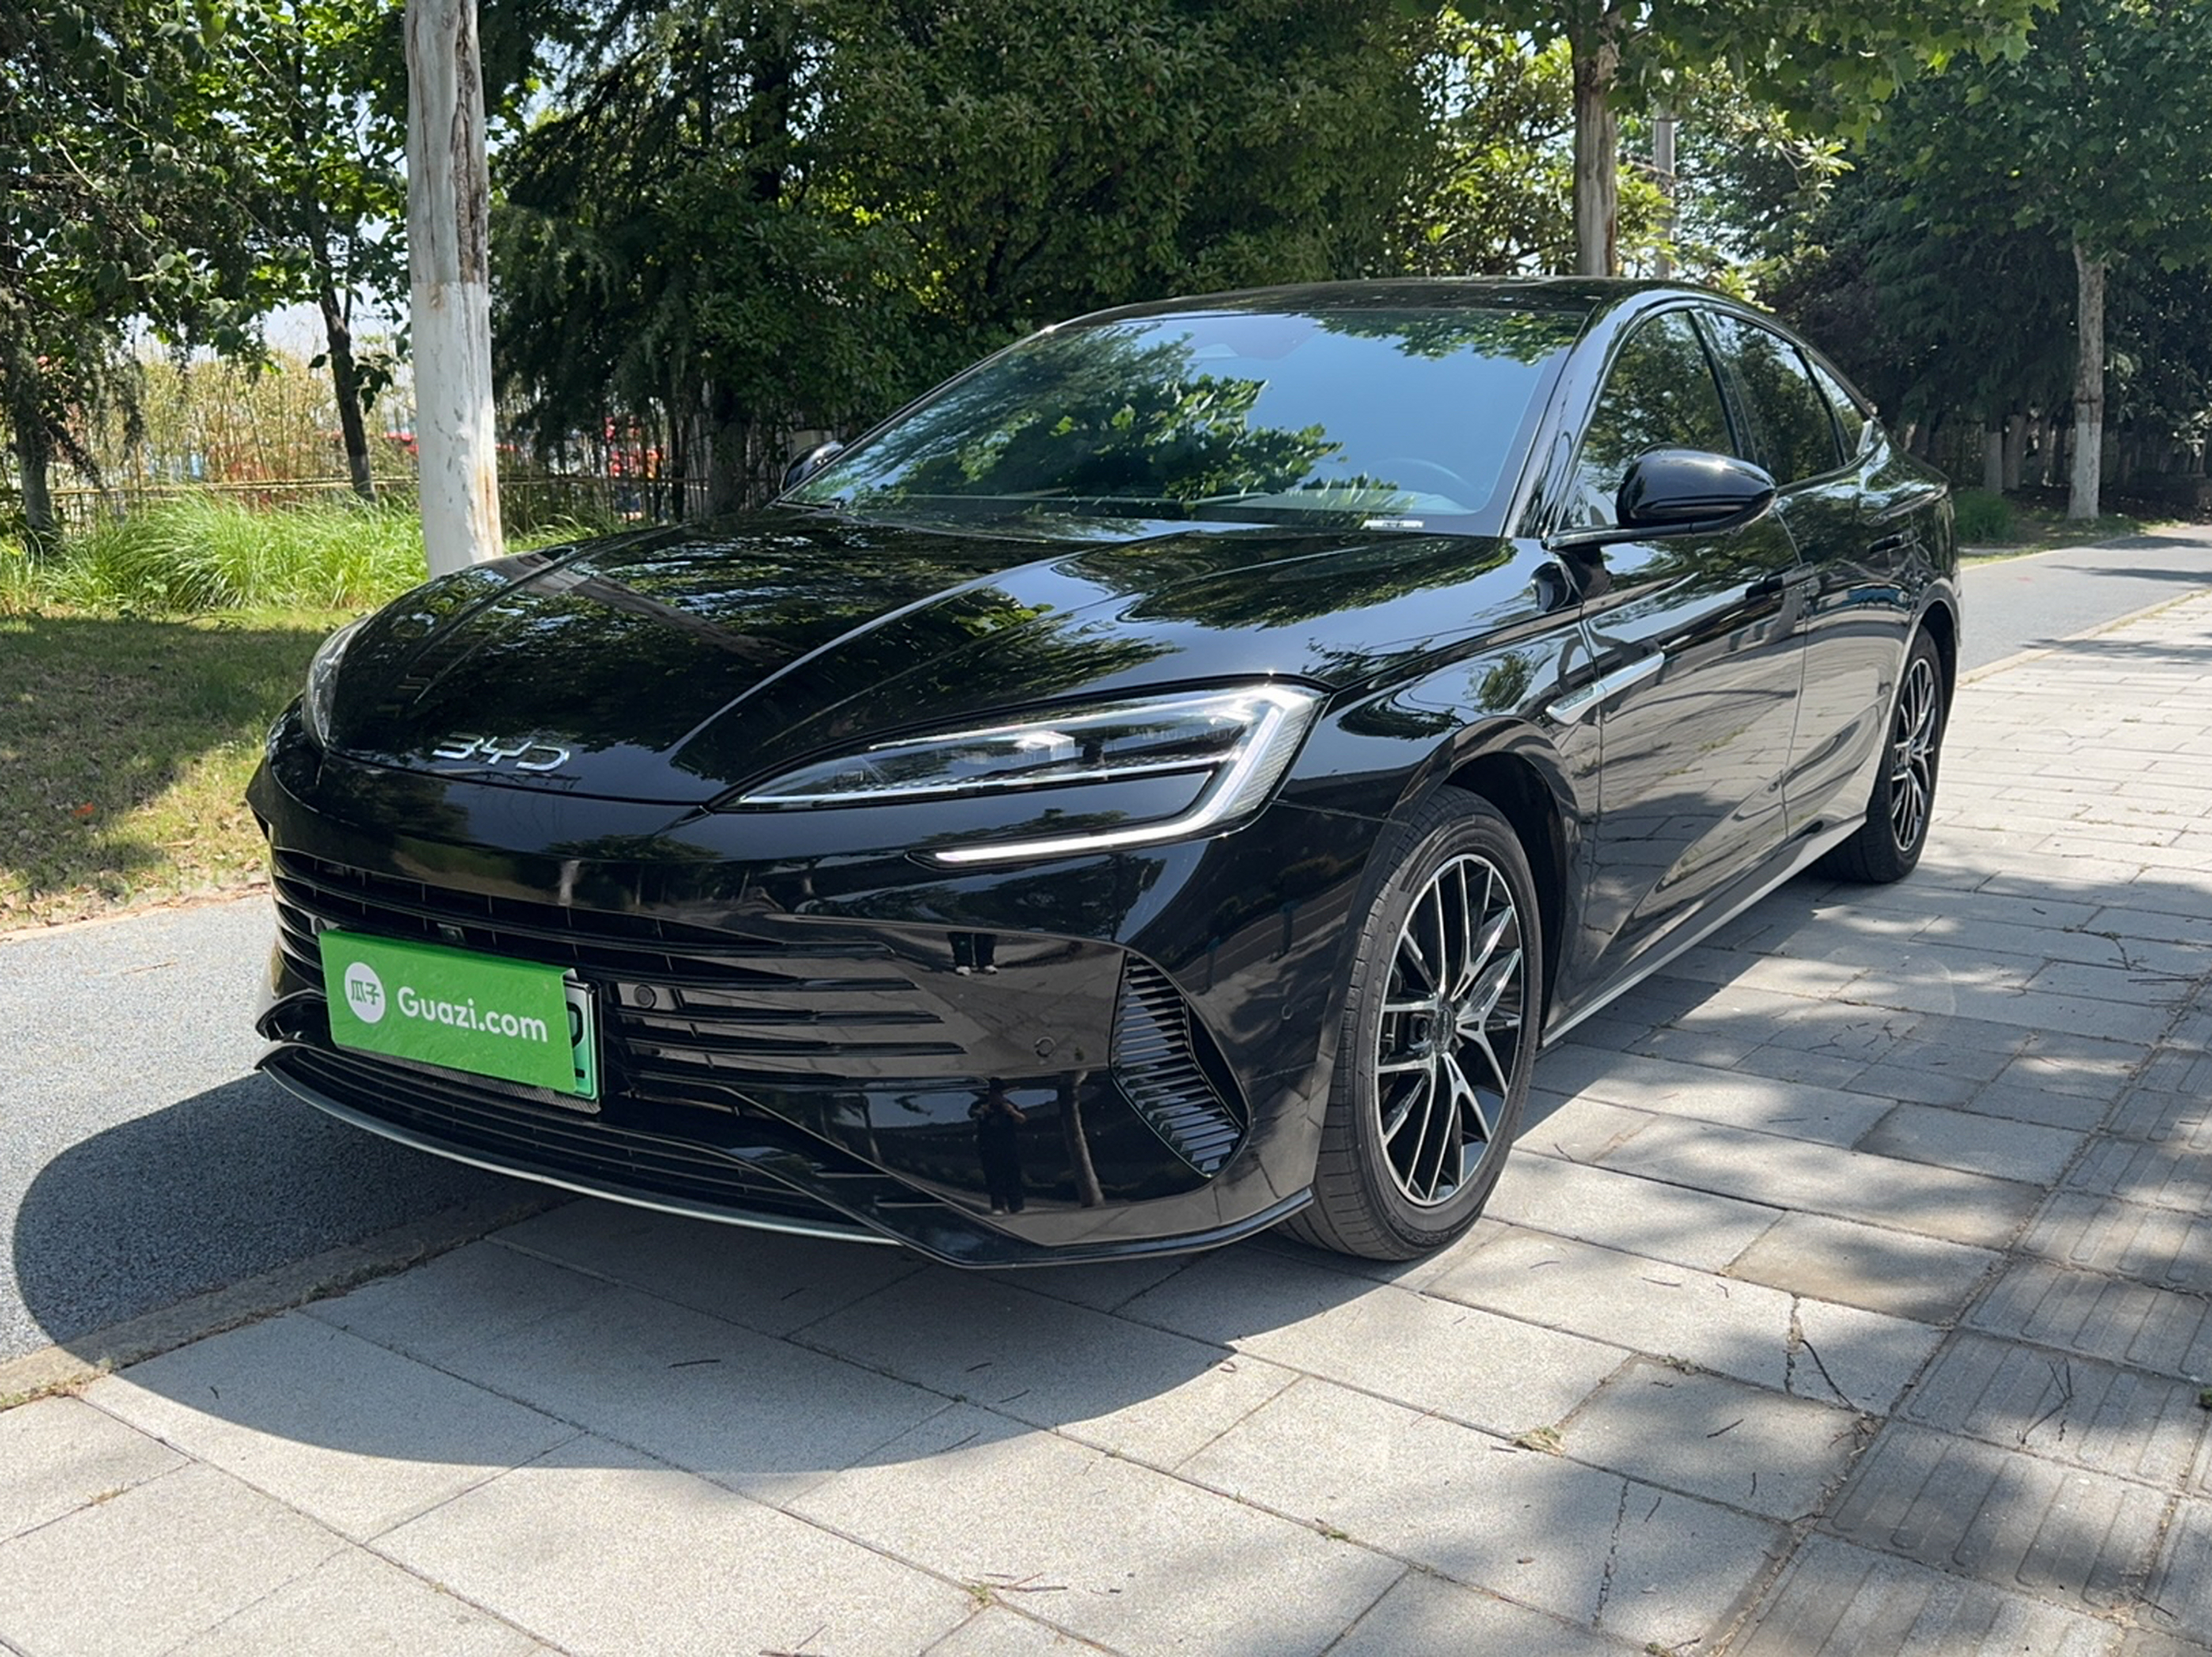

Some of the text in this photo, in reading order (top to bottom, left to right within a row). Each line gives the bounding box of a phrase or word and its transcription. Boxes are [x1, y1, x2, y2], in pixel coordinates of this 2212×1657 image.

[432, 732, 570, 771] BYD
[351, 979, 380, 1005] 瓜子
[397, 986, 548, 1042] Guazi.com
